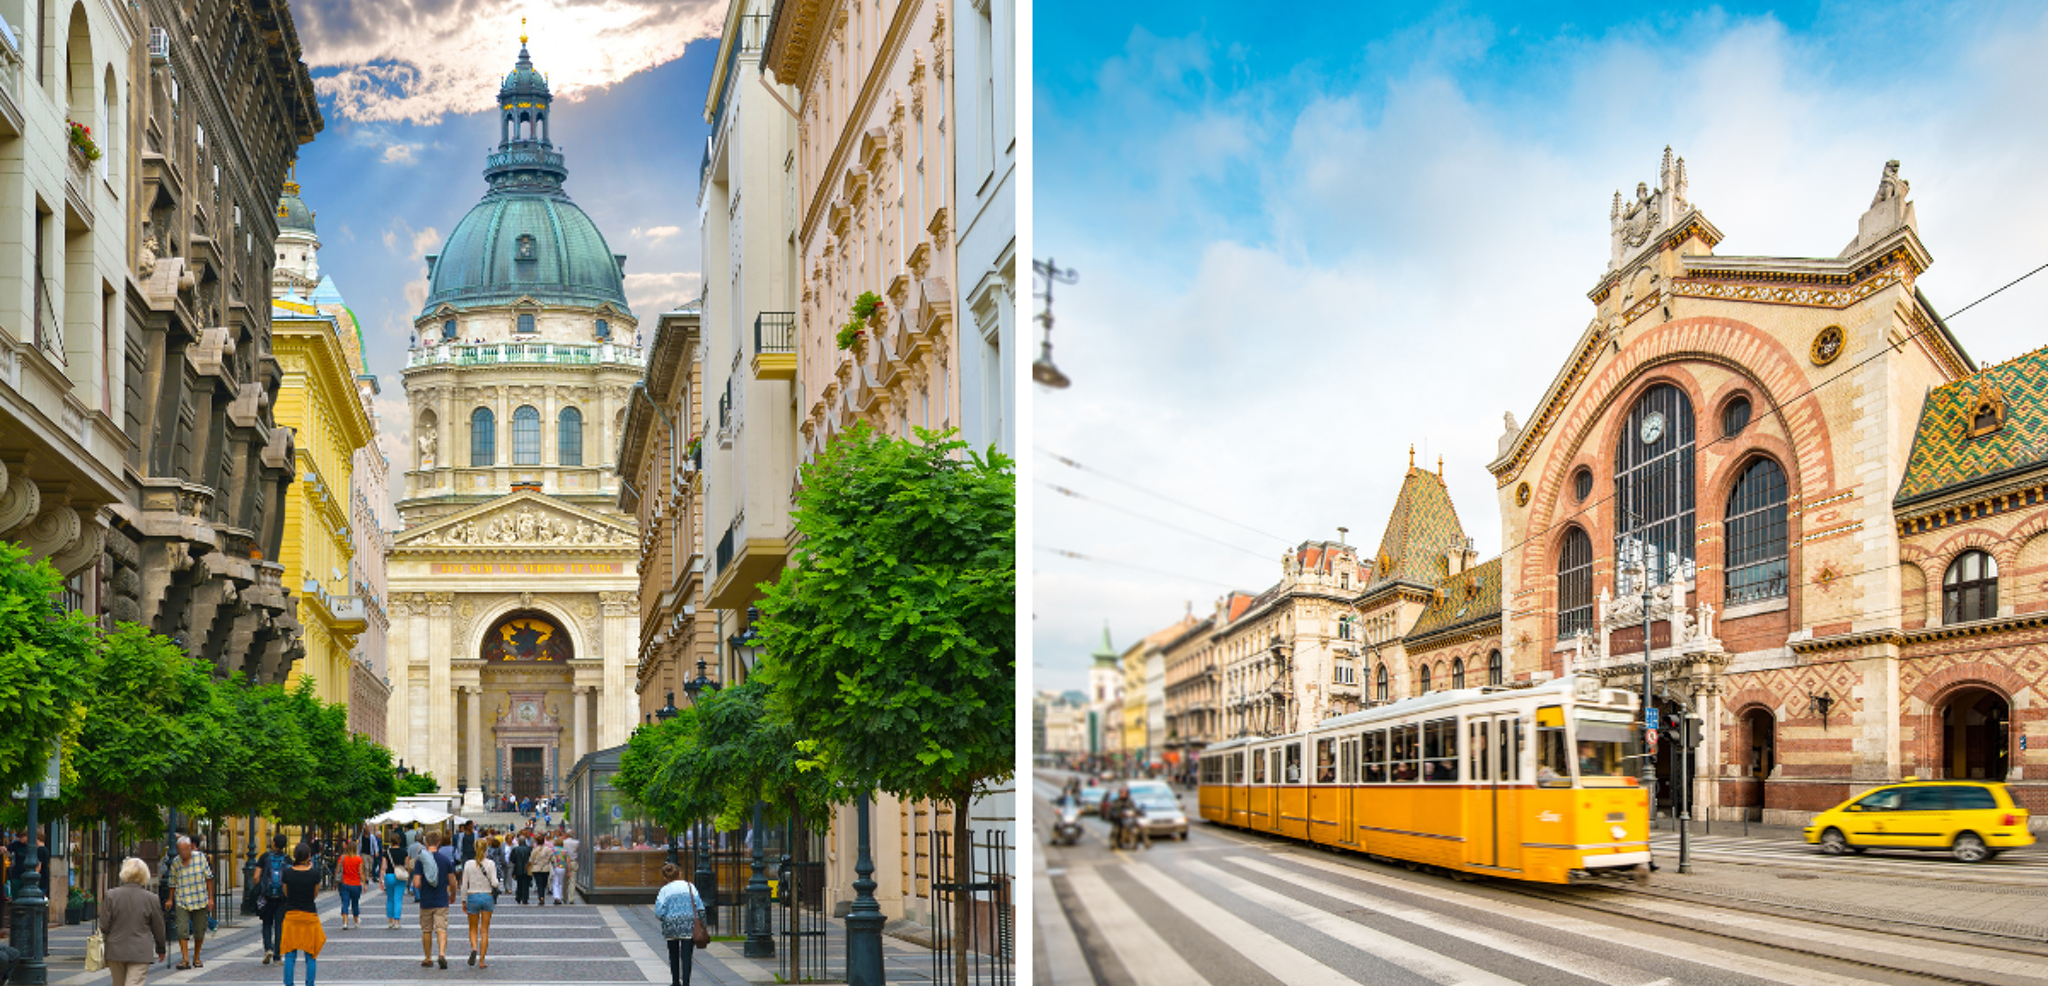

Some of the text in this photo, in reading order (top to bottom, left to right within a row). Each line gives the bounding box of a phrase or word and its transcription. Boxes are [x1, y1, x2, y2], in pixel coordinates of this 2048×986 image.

[441, 564, 463, 573] EGO
[469, 564, 492, 573] SUM
[523, 564, 566, 573] VERITAS
[571, 564, 584, 573] ET
[589, 564, 612, 573] VITA
